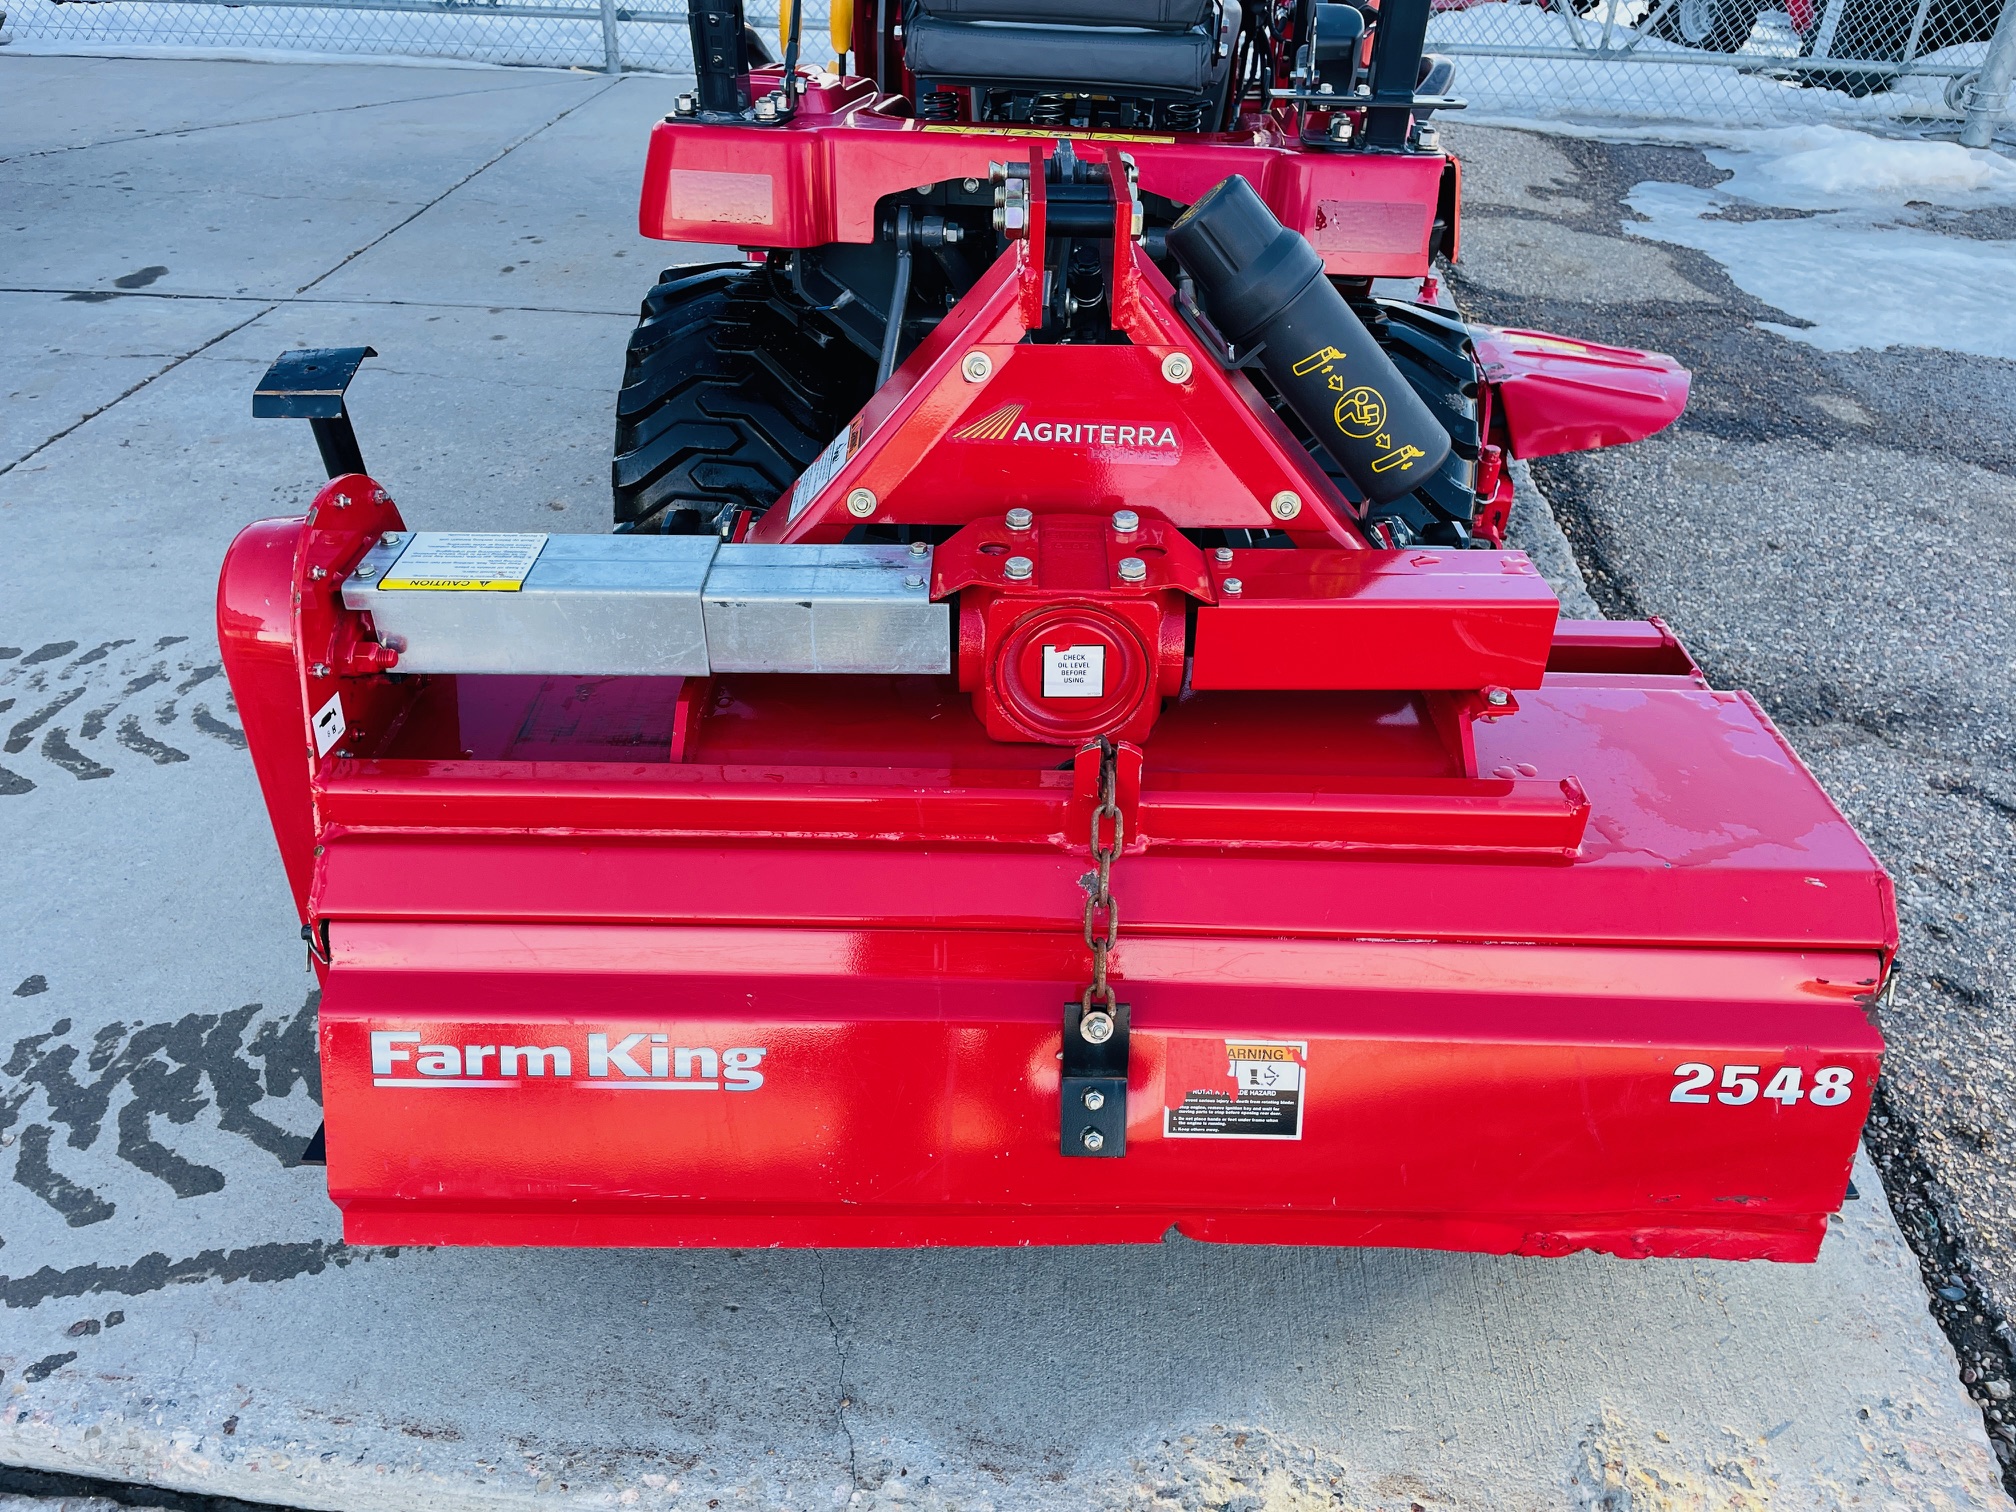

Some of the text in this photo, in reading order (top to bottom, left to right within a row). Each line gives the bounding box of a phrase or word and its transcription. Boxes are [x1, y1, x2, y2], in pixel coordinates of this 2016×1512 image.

[1013, 422, 1177, 446] AGRITERRA
[369, 1031, 767, 1092] Farm King
[1228, 1048, 1284, 1060] ARNING
[1669, 1062, 1854, 1106] 2548
